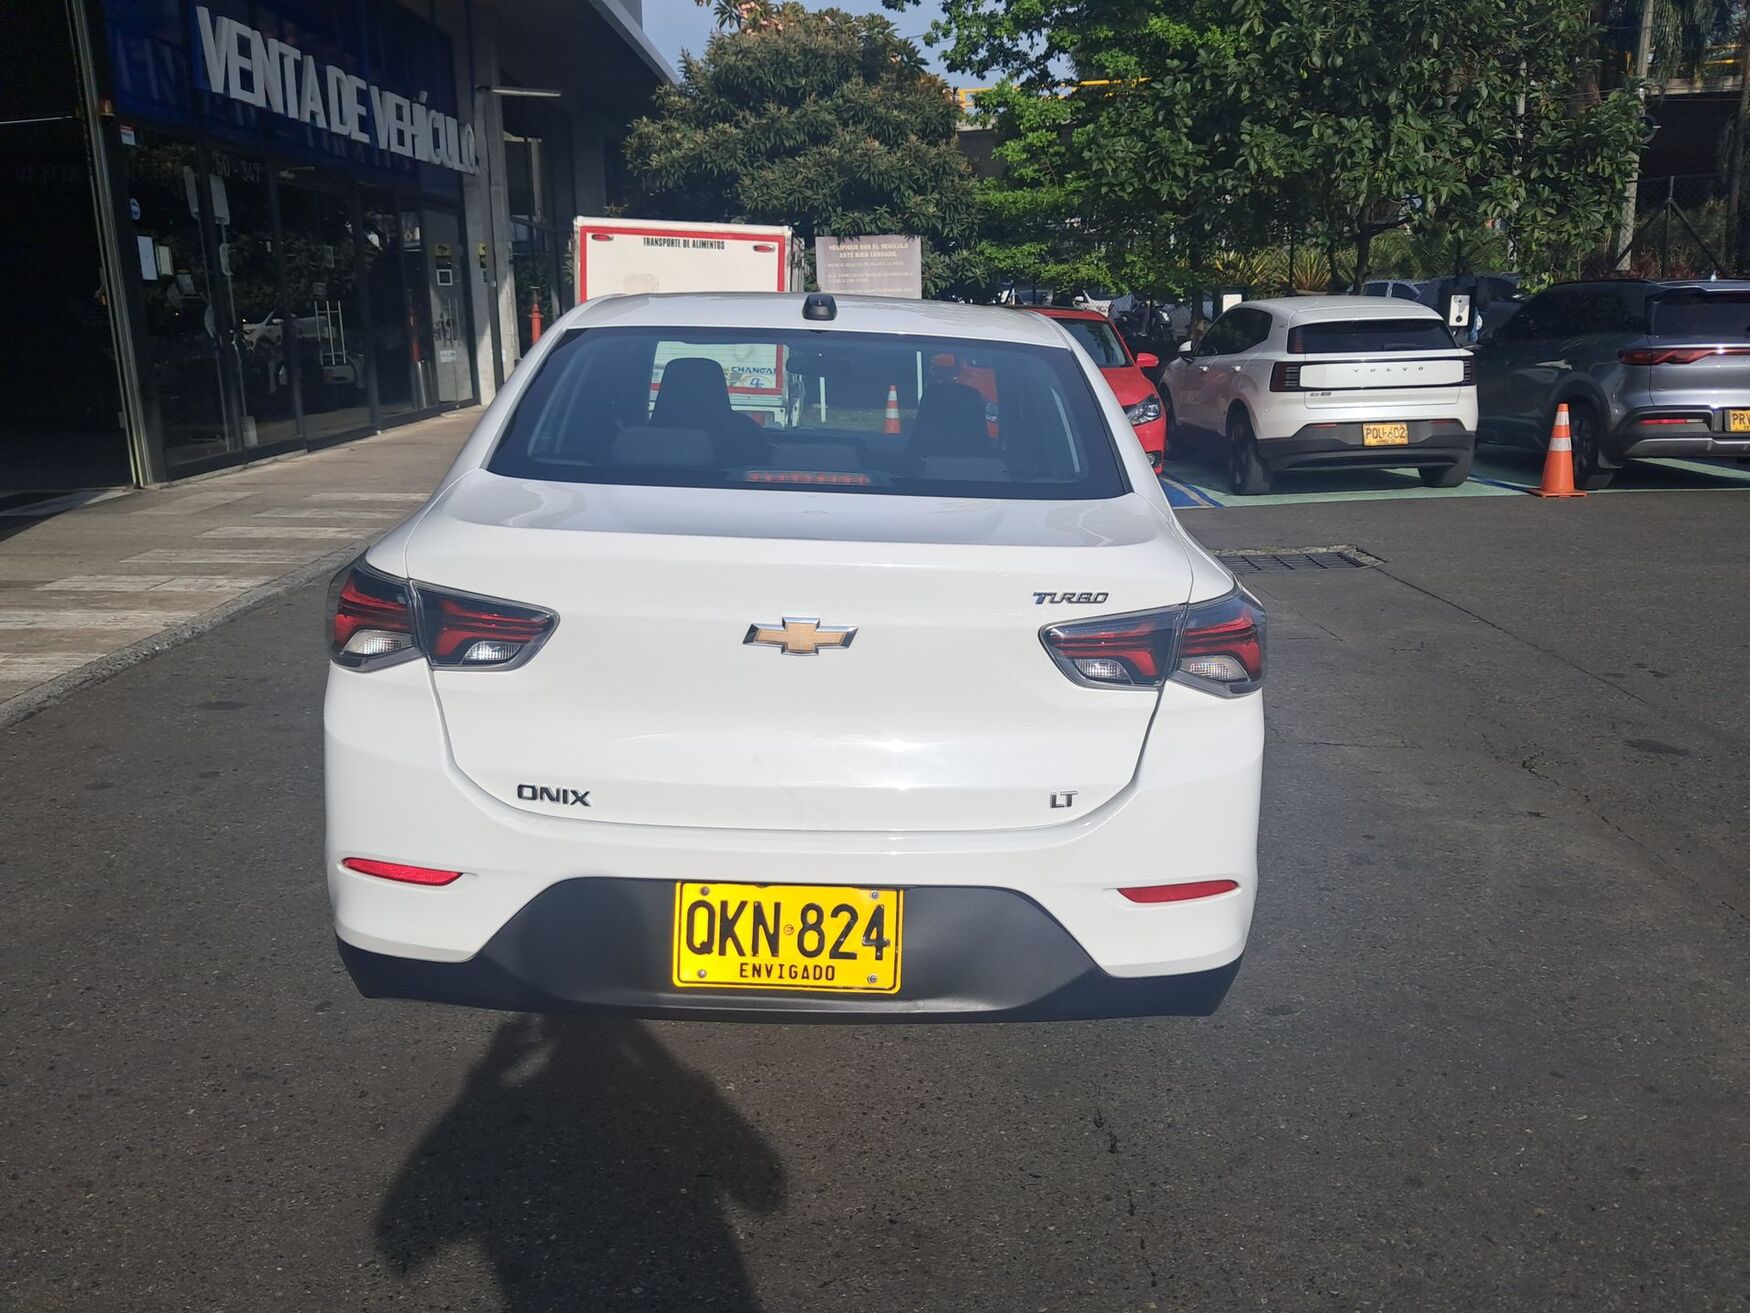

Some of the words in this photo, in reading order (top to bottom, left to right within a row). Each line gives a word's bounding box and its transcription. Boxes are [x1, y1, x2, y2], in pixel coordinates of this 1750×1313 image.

[196, 5, 327, 130] VENTA
[325, 64, 370, 144] DE
[643, 237, 681, 248] TRANSPORTE
[683, 239, 690, 248] DE
[692, 239, 725, 250] ALIMENTOS
[1032, 591, 1109, 605] TURBO
[517, 783, 591, 807] ONIX
[1050, 790, 1079, 808] LT
[686, 899, 782, 958] QKN
[797, 902, 891, 961] 824
[739, 962, 836, 981] ENVIGADO
